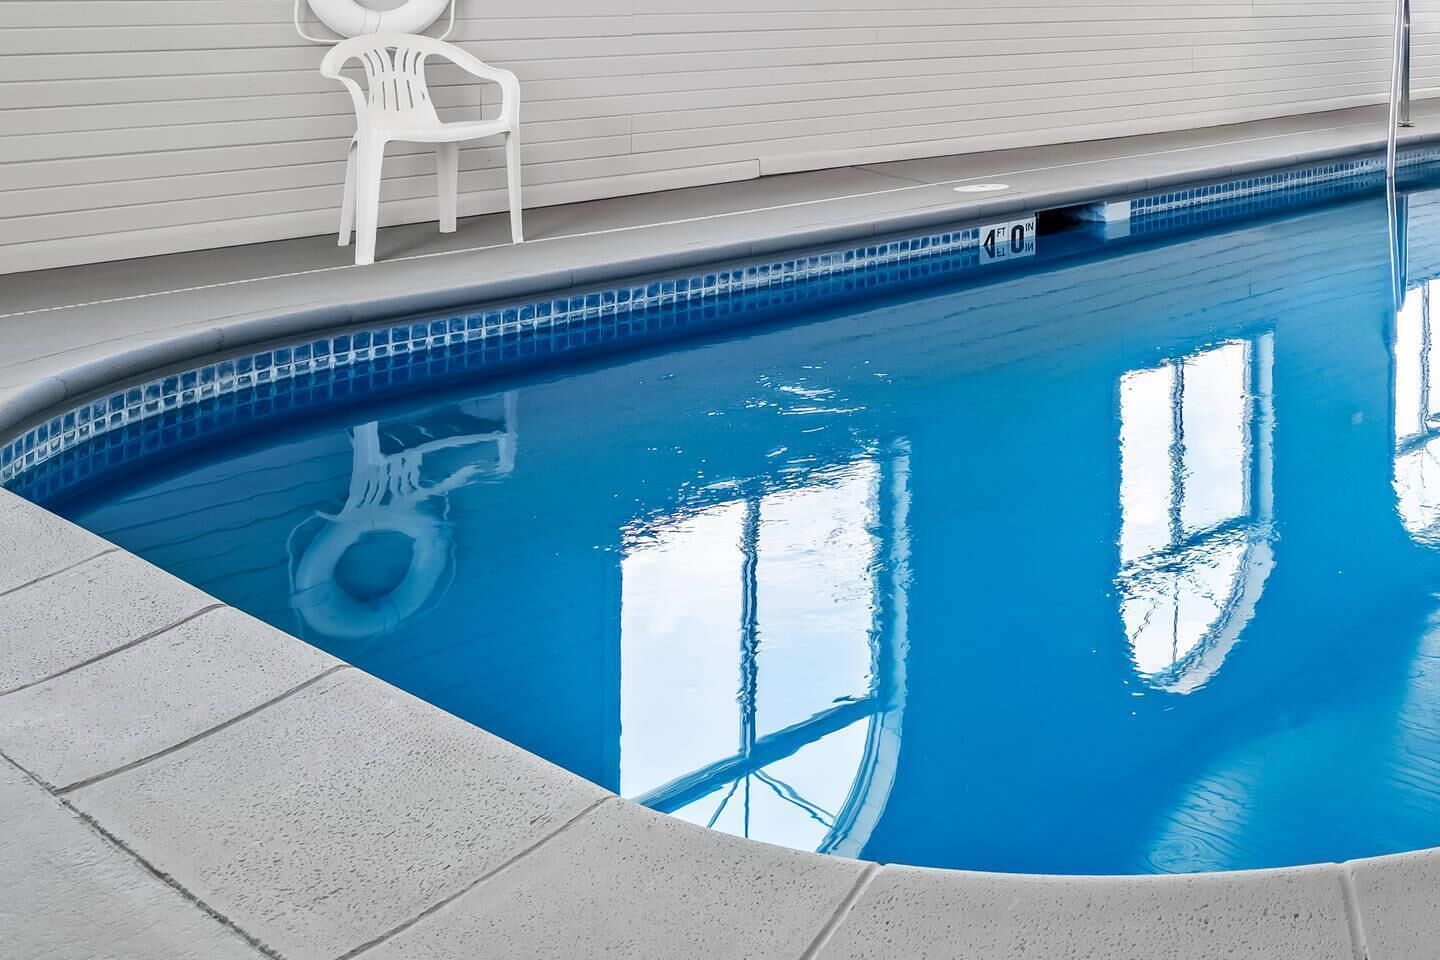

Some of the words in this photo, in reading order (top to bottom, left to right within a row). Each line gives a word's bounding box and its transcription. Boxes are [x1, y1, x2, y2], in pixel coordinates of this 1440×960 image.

[983, 229, 996, 246] 4
[997, 227, 1006, 237] FT
[1025, 222, 1034, 231] IN
